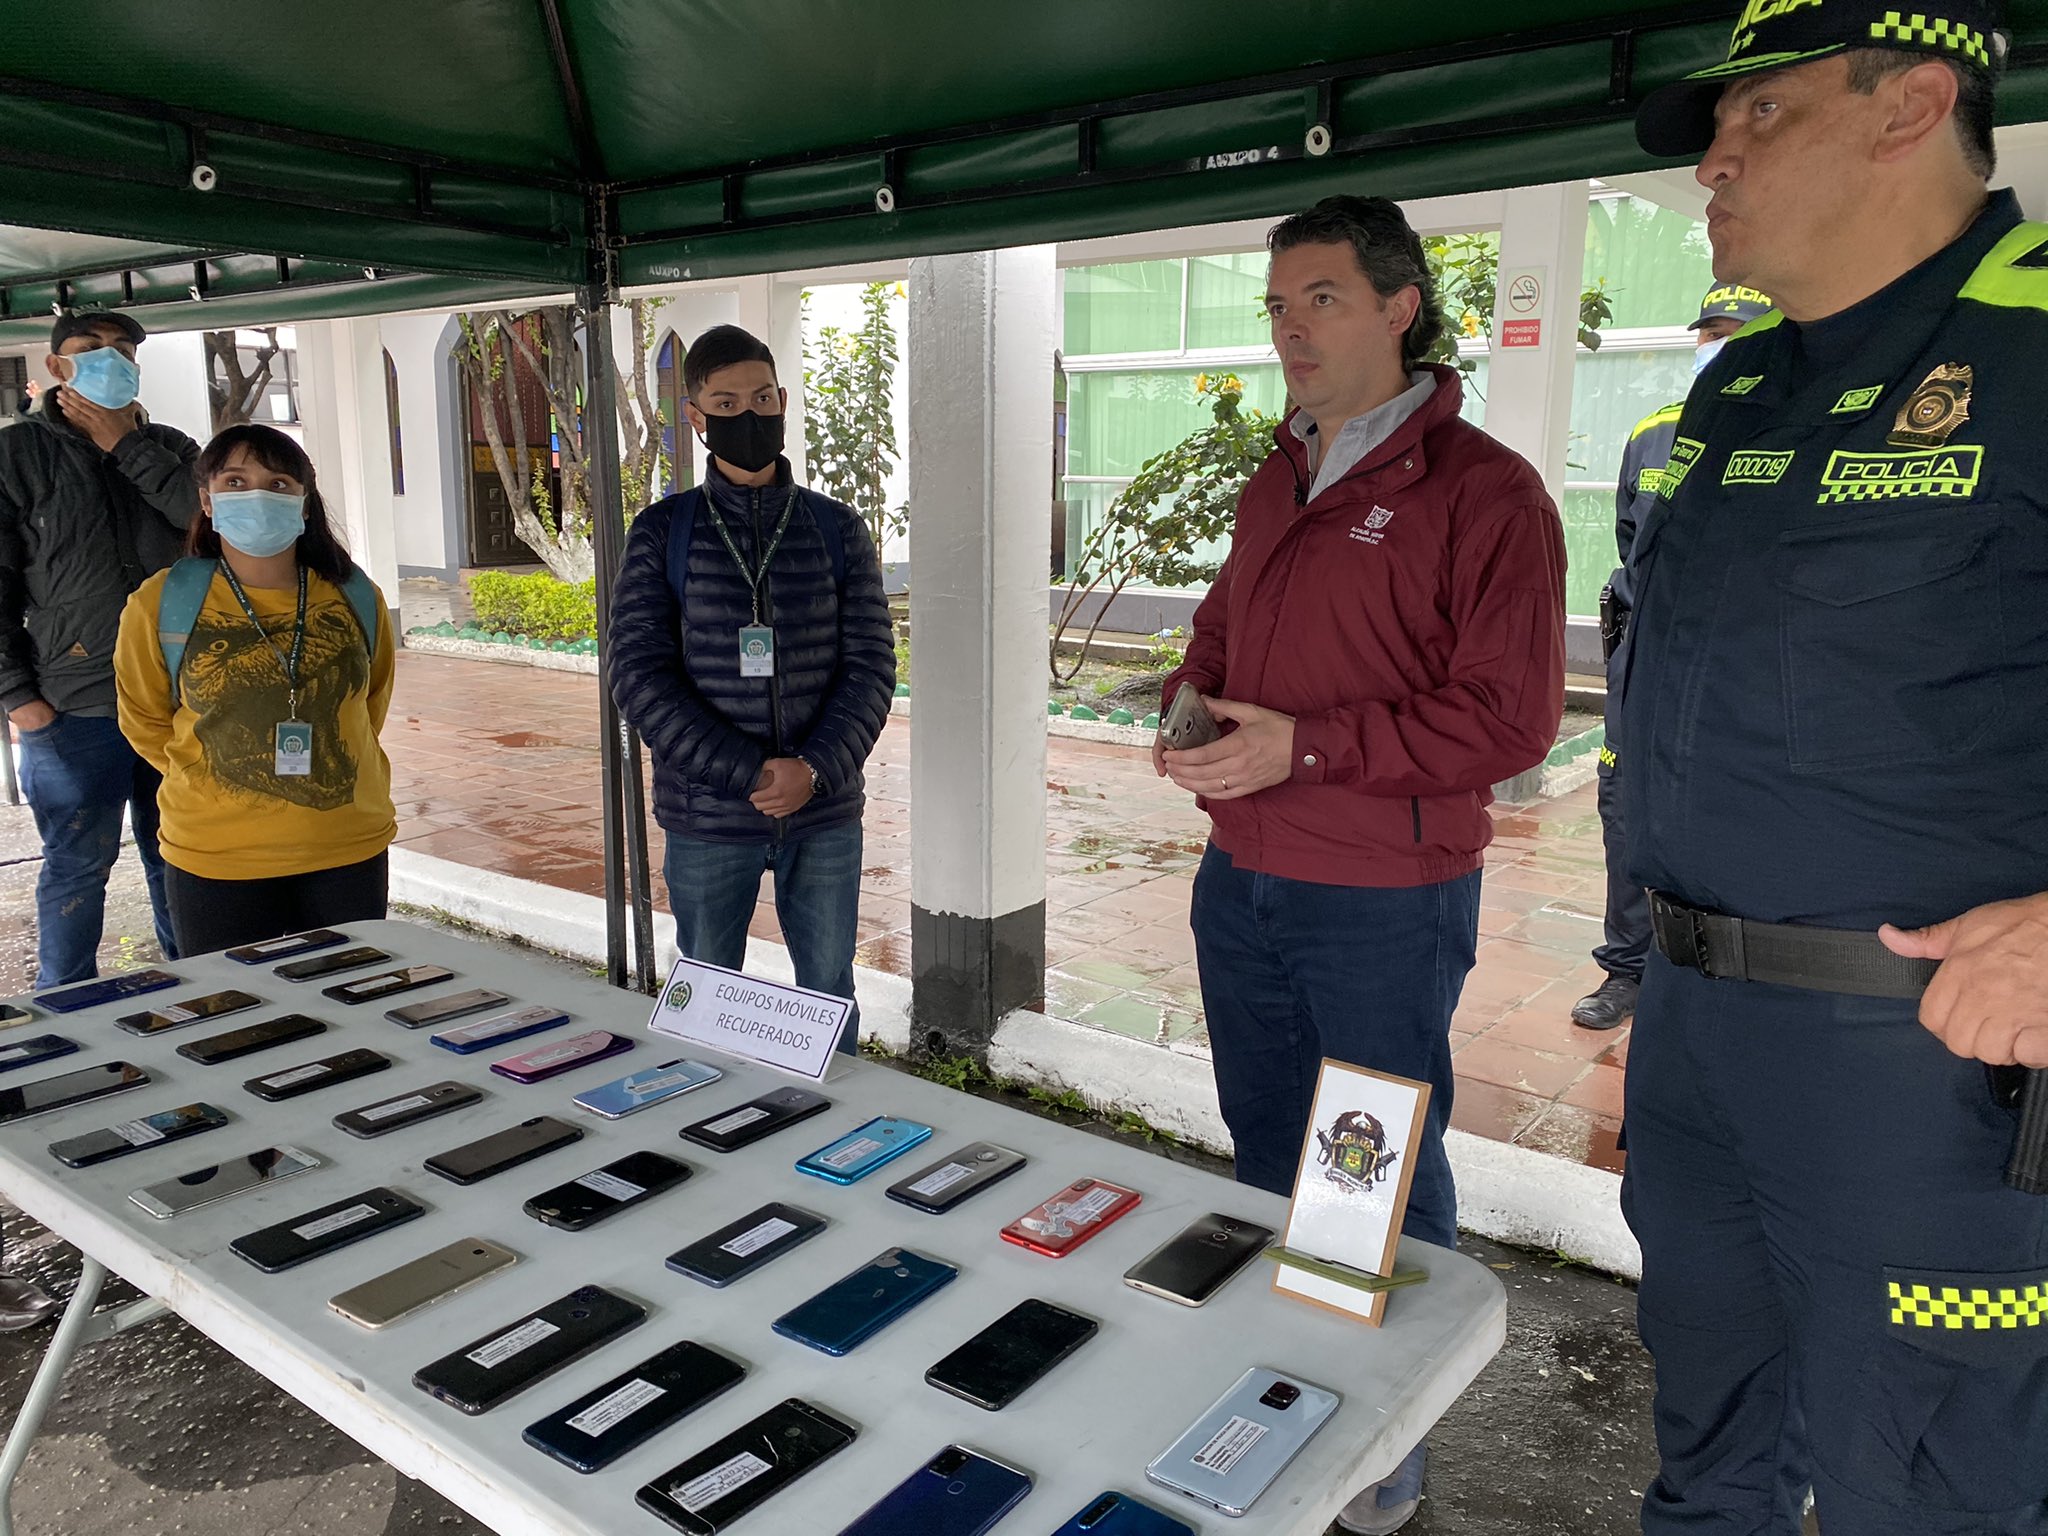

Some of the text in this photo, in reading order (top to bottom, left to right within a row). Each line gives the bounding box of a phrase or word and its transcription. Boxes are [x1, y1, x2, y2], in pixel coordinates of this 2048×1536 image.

[1267, 145, 1279, 159] 4
[683, 267, 691, 278] 4
[1504, 325, 1539, 334] PROHIBIDO
[1509, 336, 1532, 344] FUMAR
[1839, 455, 1961, 480] POLICÍA
[715, 983, 837, 1026] EQUIPOS MÓVILES
[715, 1012, 813, 1050] RECUPERADOS
